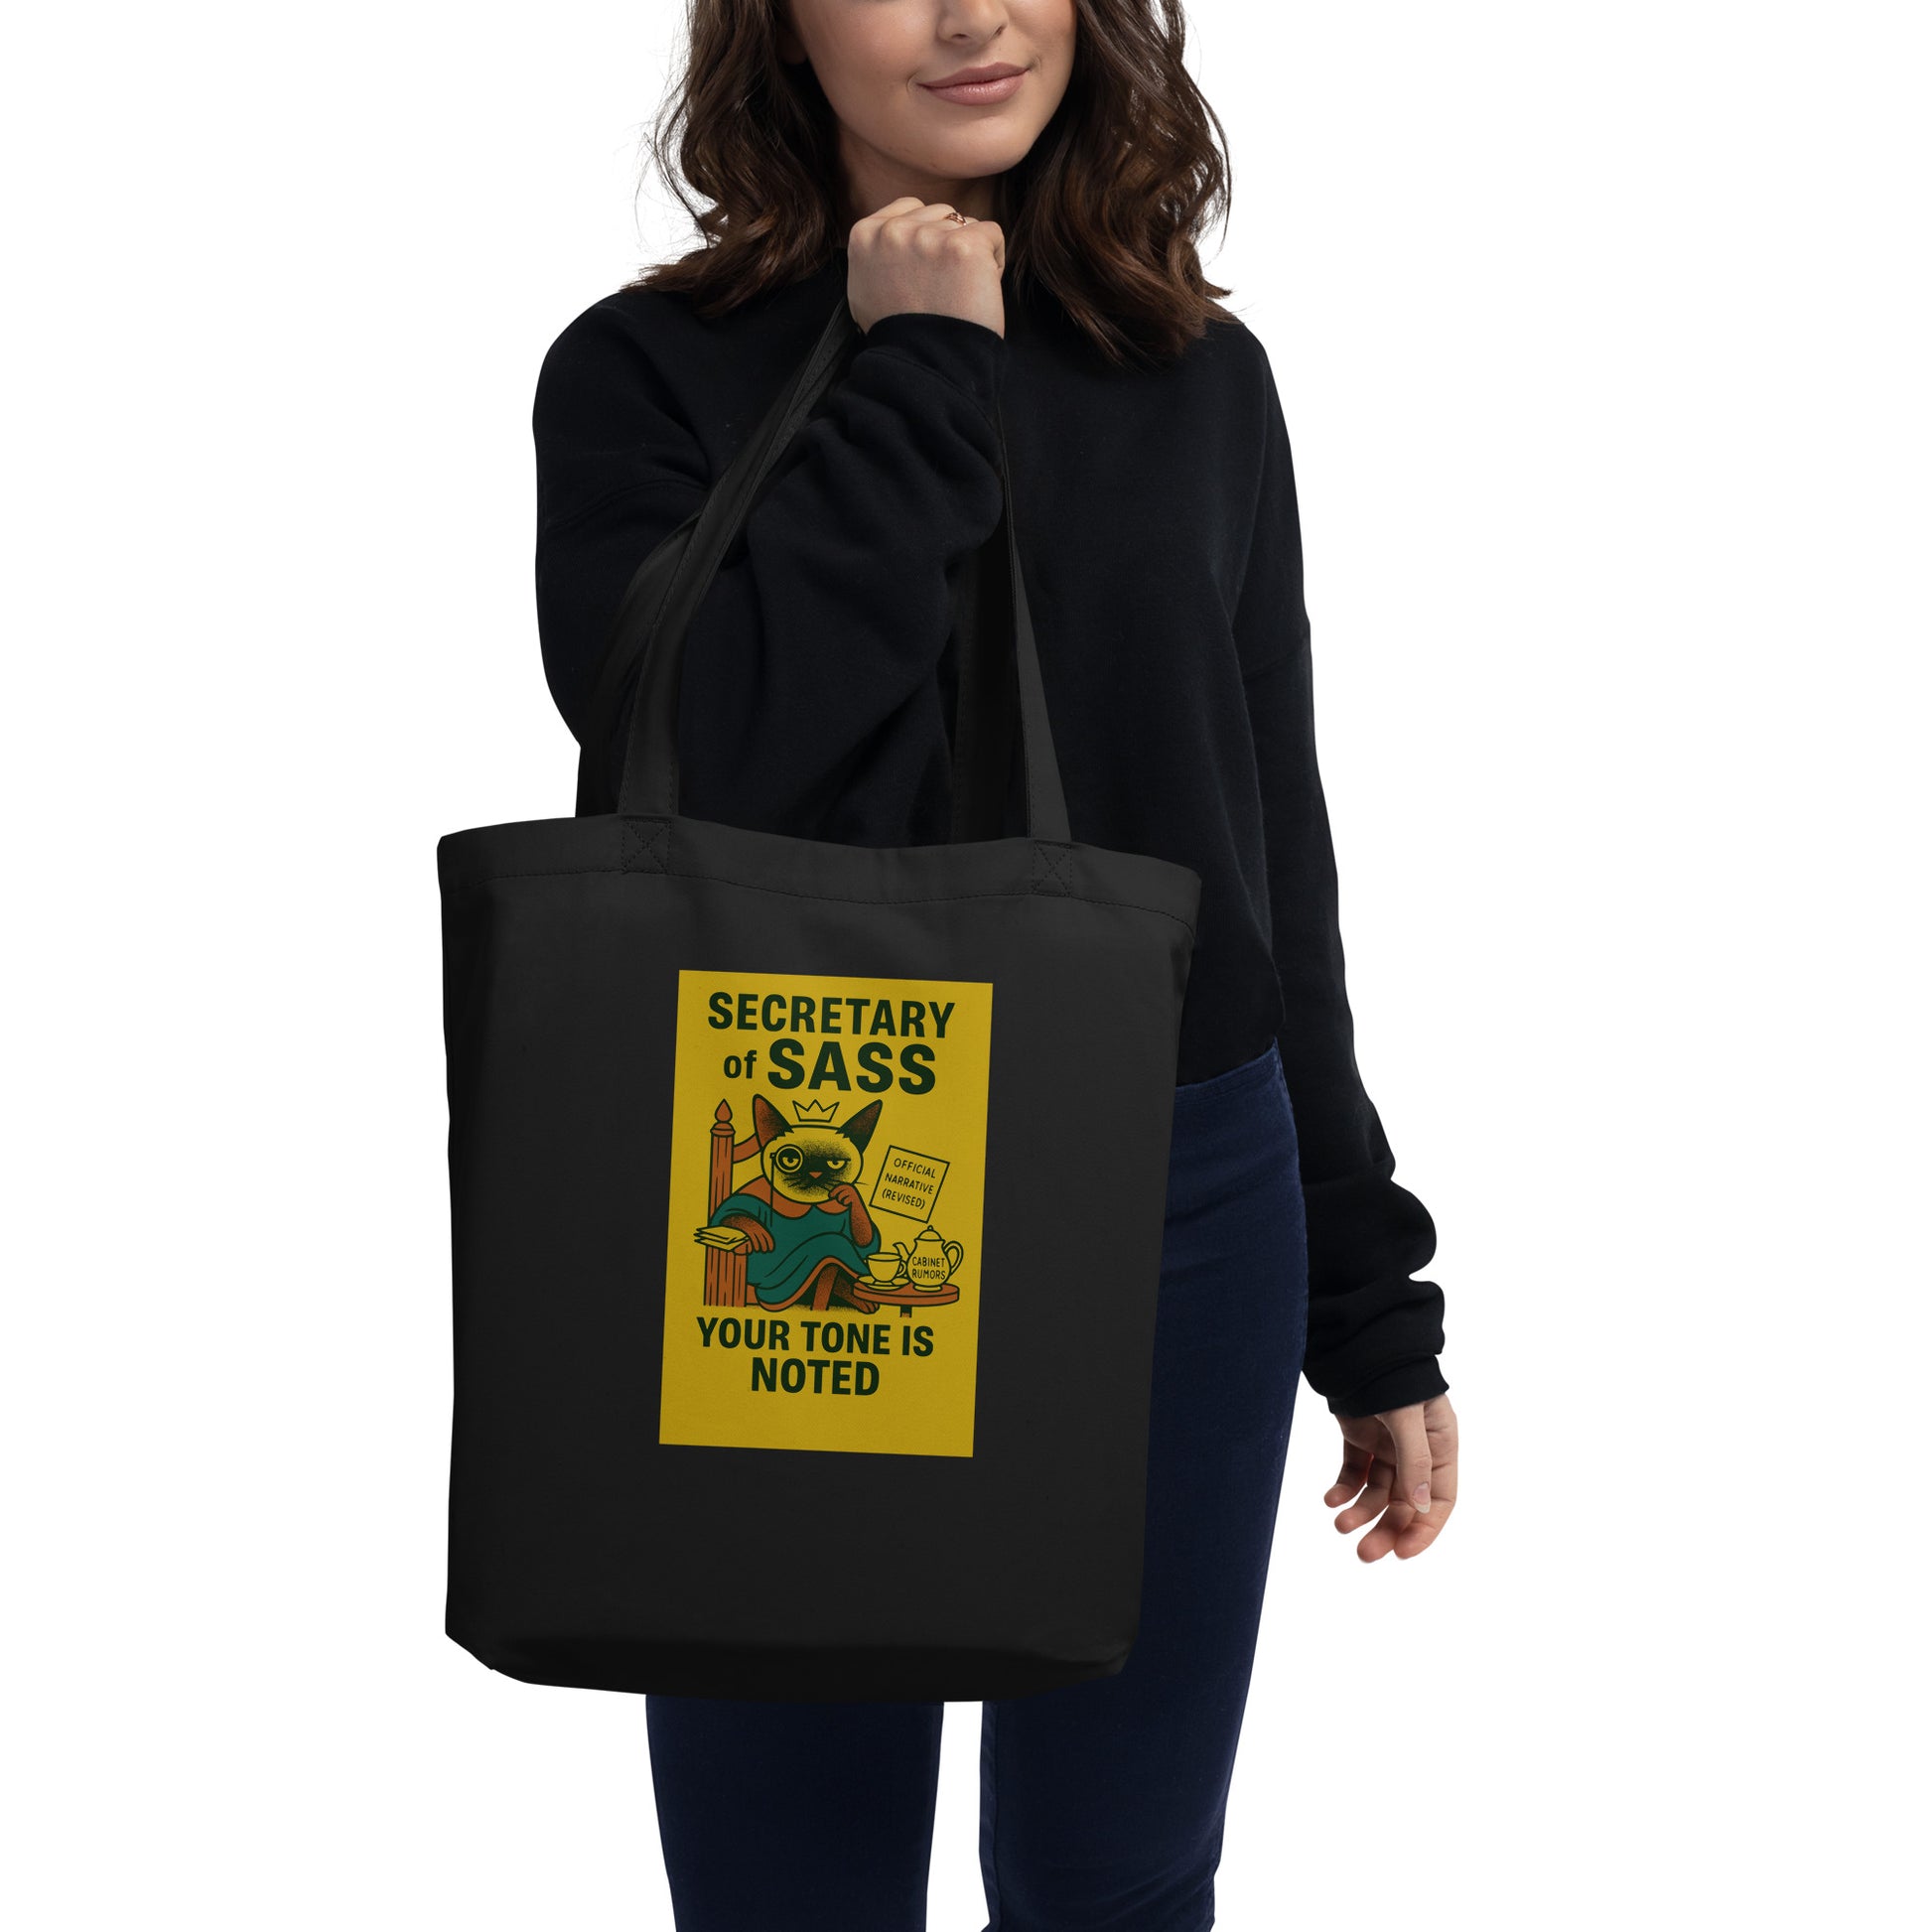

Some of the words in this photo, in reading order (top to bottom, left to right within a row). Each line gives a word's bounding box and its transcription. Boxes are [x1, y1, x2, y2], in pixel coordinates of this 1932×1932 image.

[708, 992, 955, 1038] SECRETARY
[724, 1050, 757, 1079] of
[767, 1038, 936, 1095] SASS
[894, 1158, 936, 1178] OFFICIAL
[885, 1173, 934, 1194] NARRATIVE
[882, 1187, 925, 1209] (REVISED)
[911, 1256, 945, 1268] CABINET
[911, 1268, 946, 1280] RUMORS
[697, 1316, 790, 1350] YOUR
[800, 1321, 891, 1355] TONE
[901, 1325, 934, 1357] IS
[751, 1357, 880, 1396] NOTED
